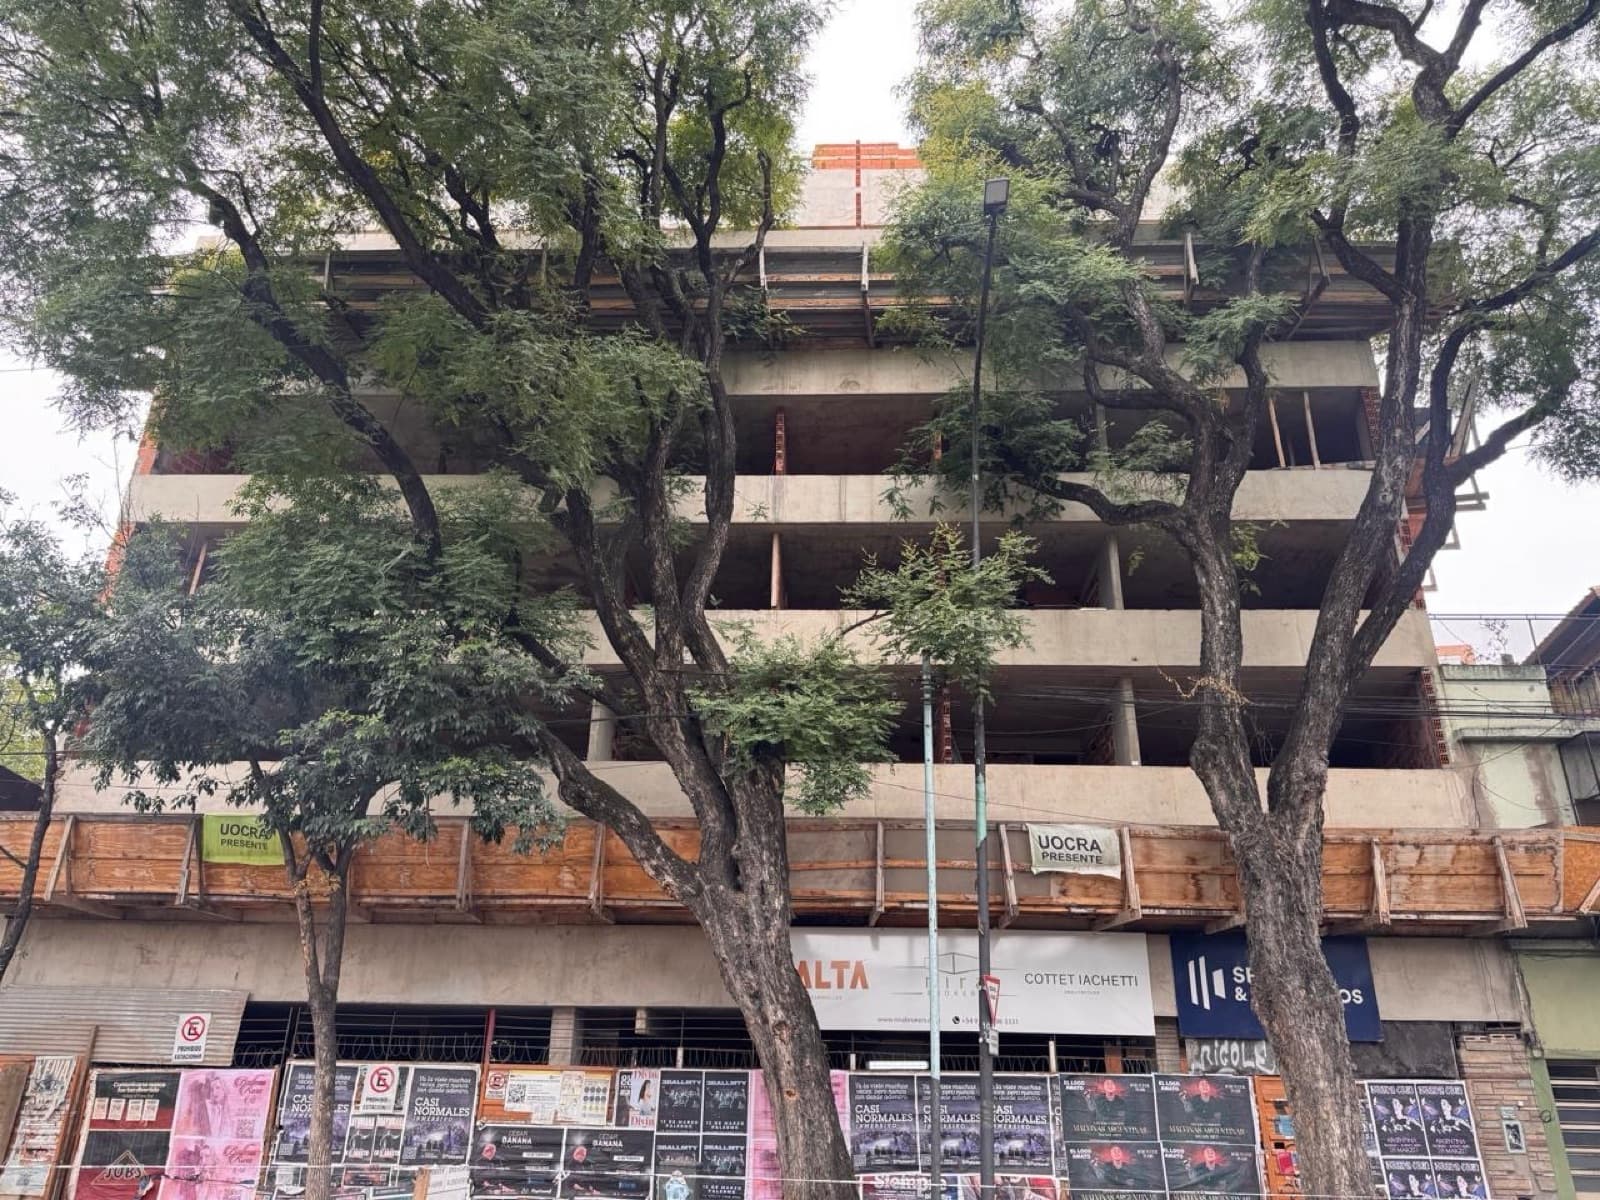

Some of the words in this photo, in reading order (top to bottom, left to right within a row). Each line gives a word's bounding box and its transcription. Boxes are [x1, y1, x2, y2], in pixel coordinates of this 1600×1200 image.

[220, 823, 269, 840] UOCRA
[220, 838, 268, 850] PRESENTE
[1038, 835, 1102, 853] UOCRA
[1041, 851, 1103, 864] PRESENTE
[1024, 973, 1075, 985] COTTET
[1079, 974, 1138, 987] IACHETTI
[1235, 986, 1247, 1001] &
[415, 1097, 440, 1107] CASI
[414, 1106, 471, 1117] NORMALES
[855, 1104, 880, 1114] CASI
[855, 1113, 913, 1123] NORMALES
[592, 1139, 623, 1147] BANANA
